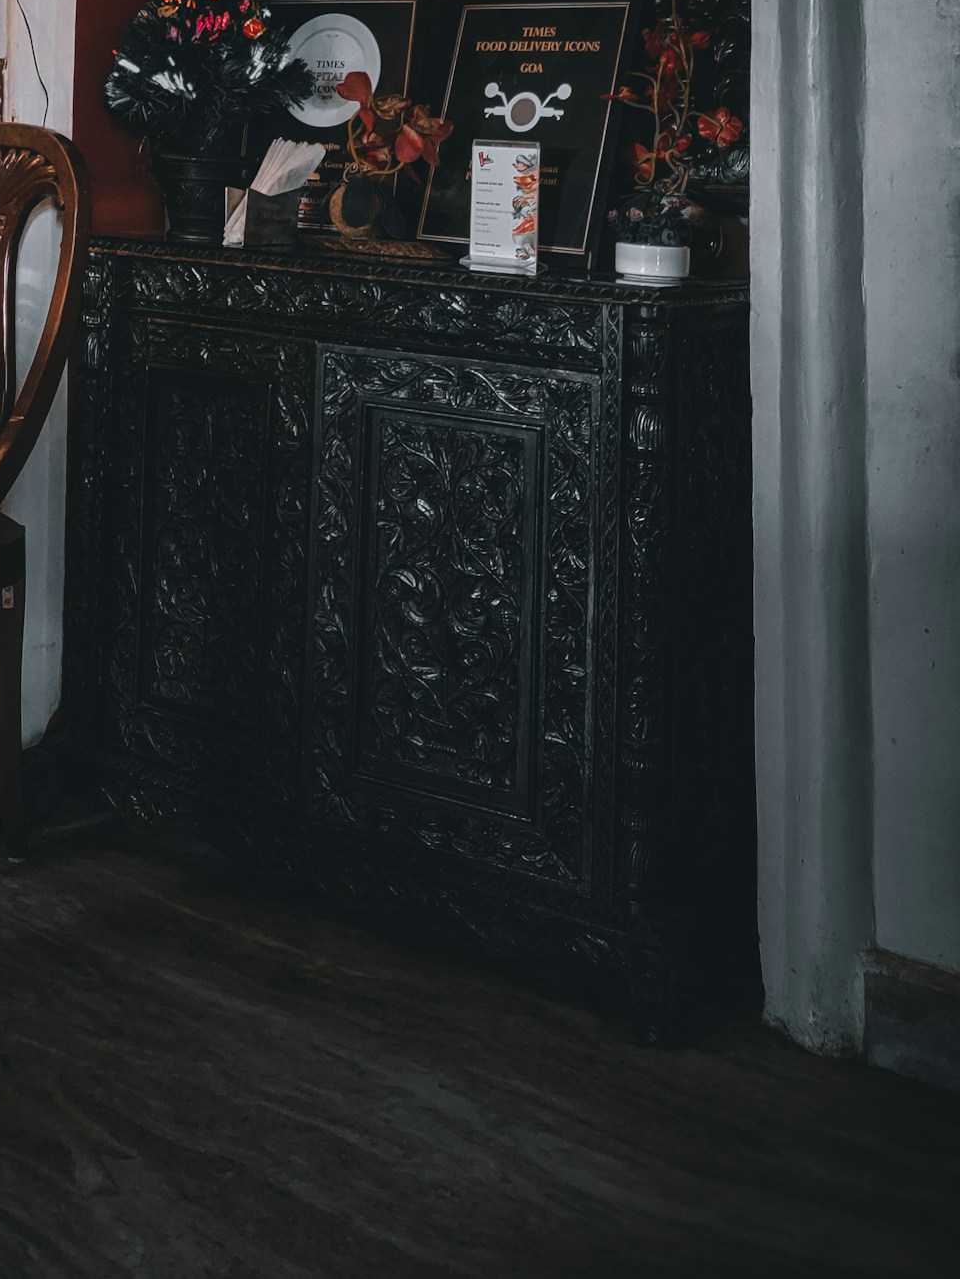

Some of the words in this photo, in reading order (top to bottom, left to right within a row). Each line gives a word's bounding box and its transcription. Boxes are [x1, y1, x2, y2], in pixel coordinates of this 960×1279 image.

[522, 26, 557, 38] TIMES
[475, 40, 507, 52] FOOD
[508, 40, 563, 52] DELIVERY
[563, 40, 602, 52] ICONS
[316, 60, 346, 69] TIMES
[520, 62, 544, 74] GOA
